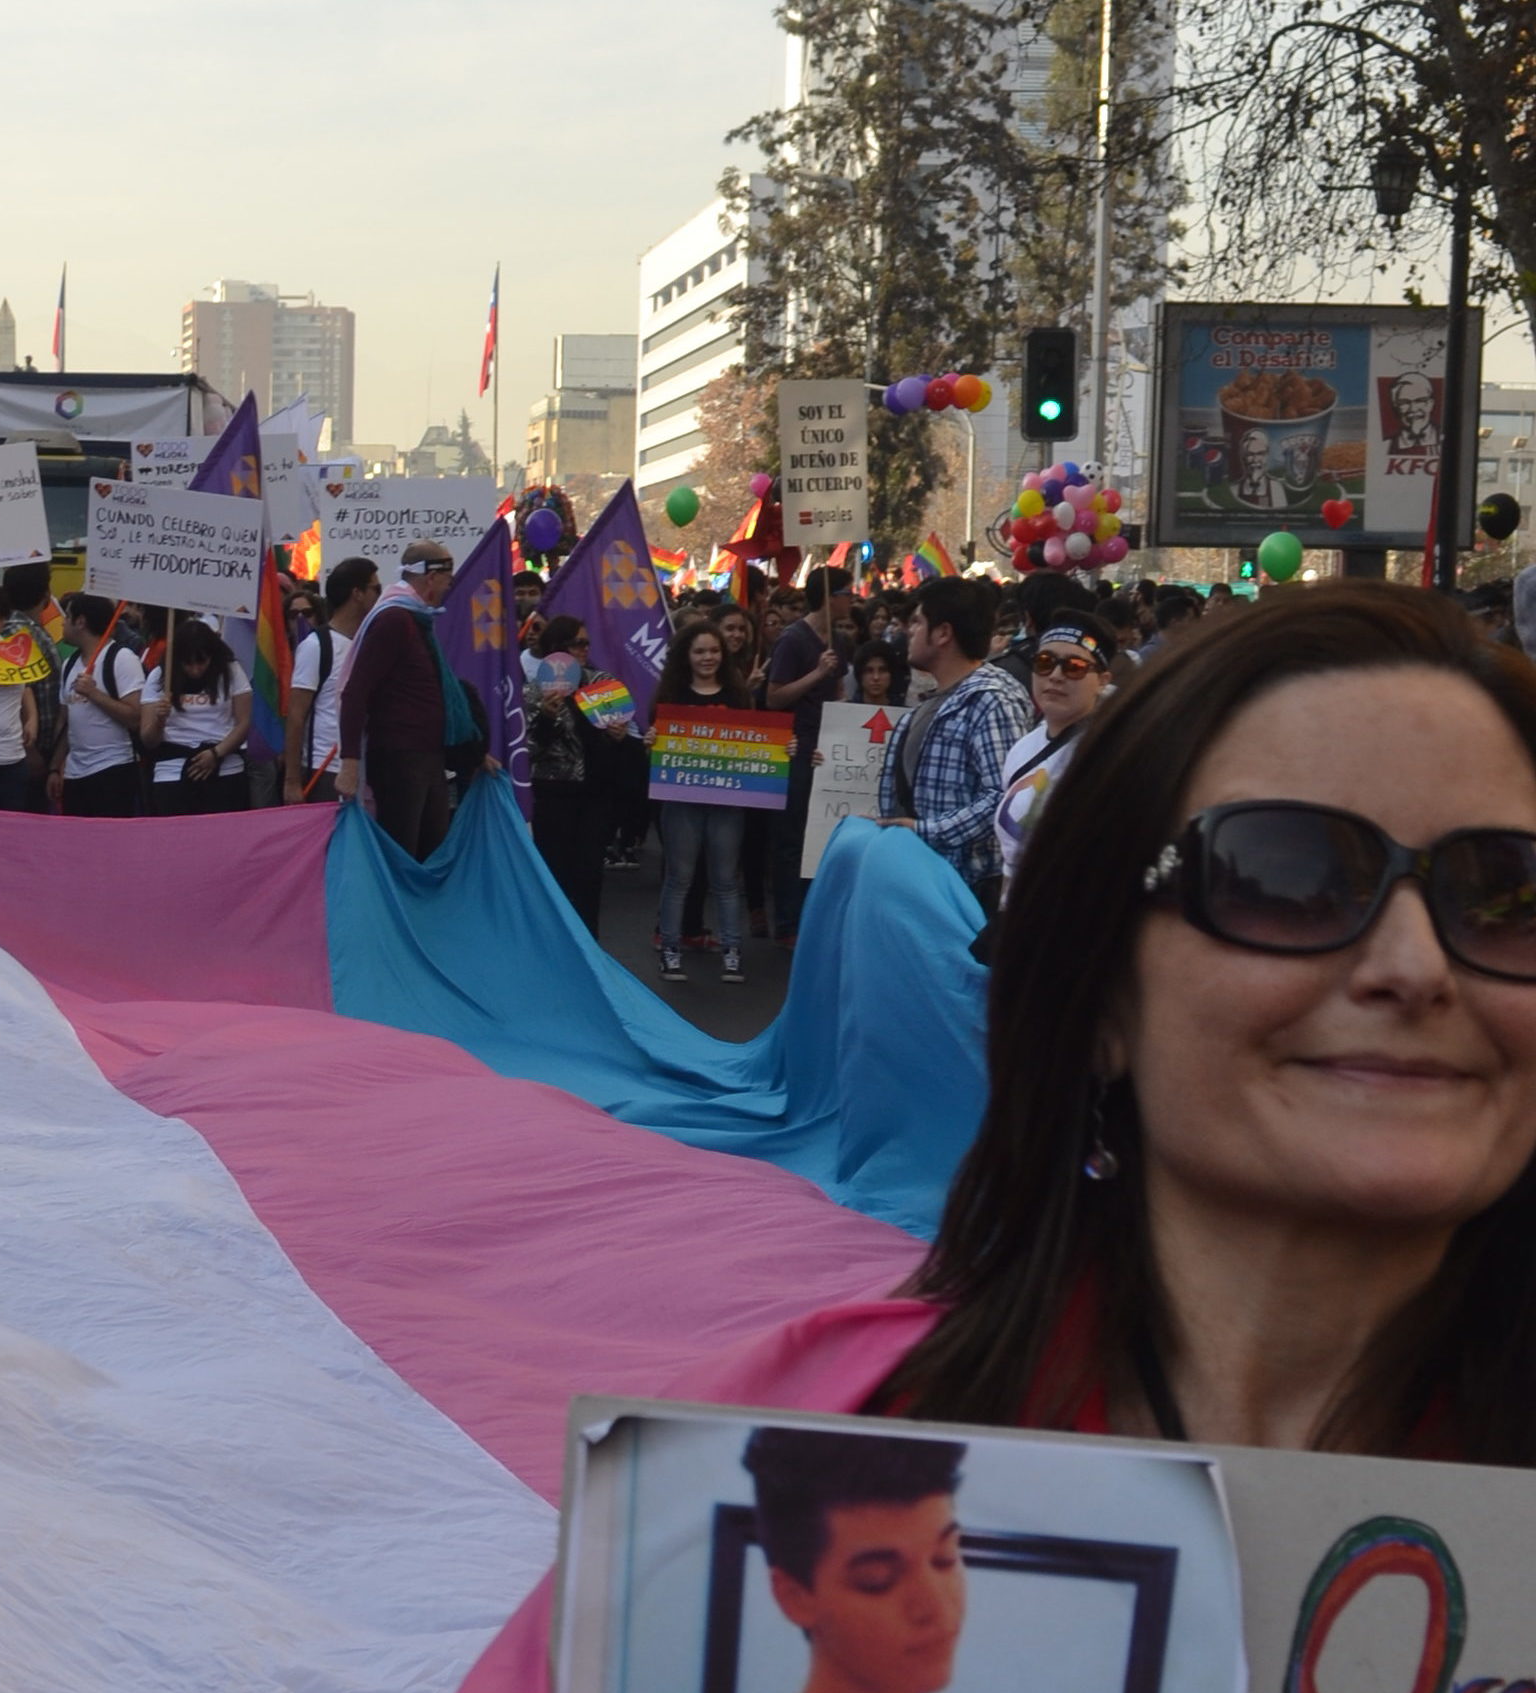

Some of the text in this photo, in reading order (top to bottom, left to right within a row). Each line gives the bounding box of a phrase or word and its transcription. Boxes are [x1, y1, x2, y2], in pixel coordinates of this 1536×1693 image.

[1212, 327, 1331, 350] Comparte
[1212, 350, 1232, 367] el
[798, 404, 846, 420] SOY EL
[800, 426, 844, 444] ÚNICO
[790, 450, 858, 469] DUEÑO DE
[787, 476, 862, 493] MI CUERPO
[96, 507, 156, 528] CUANDO
[162, 515, 217, 538] CELEBRO
[814, 505, 853, 528] iguales
[328, 526, 381, 541] CUANDO
[385, 527, 407, 540] TE
[411, 525, 466, 540] QUIERES
[128, 530, 142, 544] LE
[147, 533, 196, 550] MUESTRO
[197, 540, 214, 554] AL
[217, 543, 258, 559] MUNDO
[361, 543, 400, 556] COMO
[99, 547, 123, 560] QUE
[129, 552, 253, 581] #TODOMEJORA
[831, 744, 886, 764] EL GE
[824, 802, 852, 819] NO
